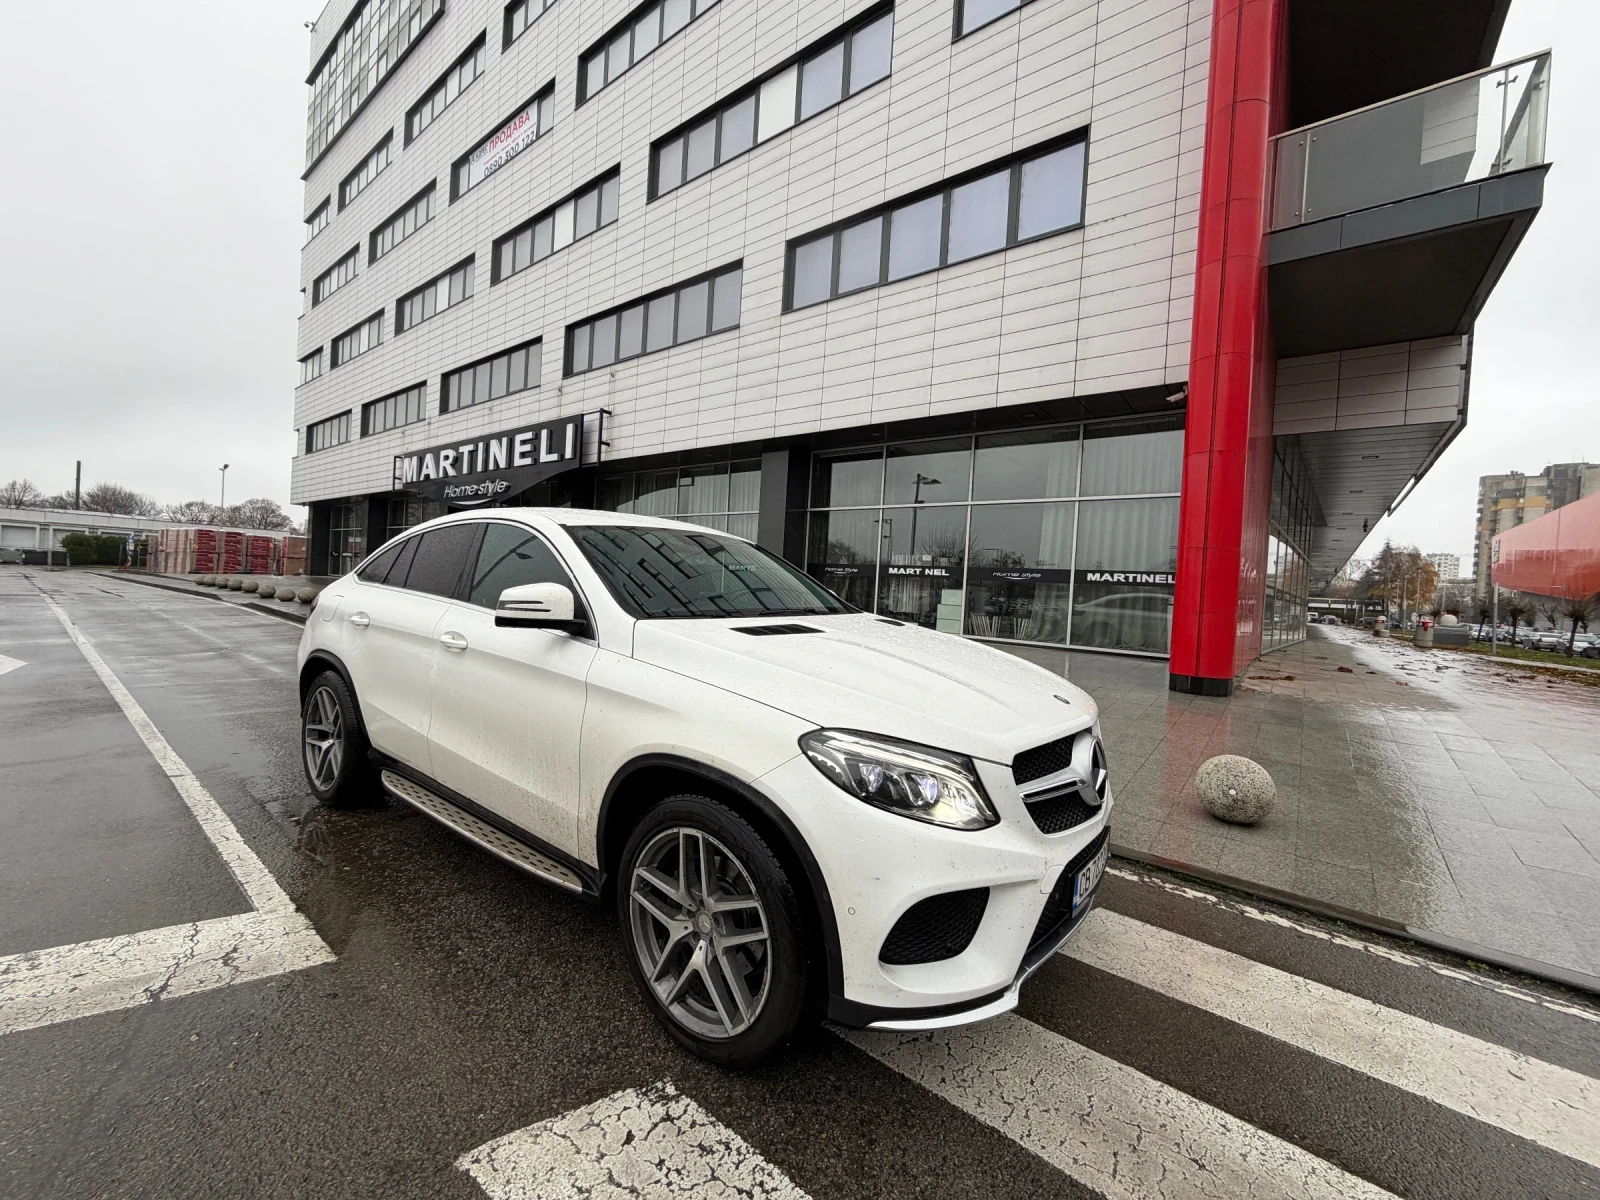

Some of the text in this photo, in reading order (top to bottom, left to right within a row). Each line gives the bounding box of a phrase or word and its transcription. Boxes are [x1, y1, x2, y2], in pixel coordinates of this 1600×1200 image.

[489, 110, 531, 153] ПРОДАВА
[504, 142, 519, 162] 300
[521, 130, 535, 149] 122
[402, 422, 580, 484] MARTINELI
[443, 478, 508, 499] Home style
